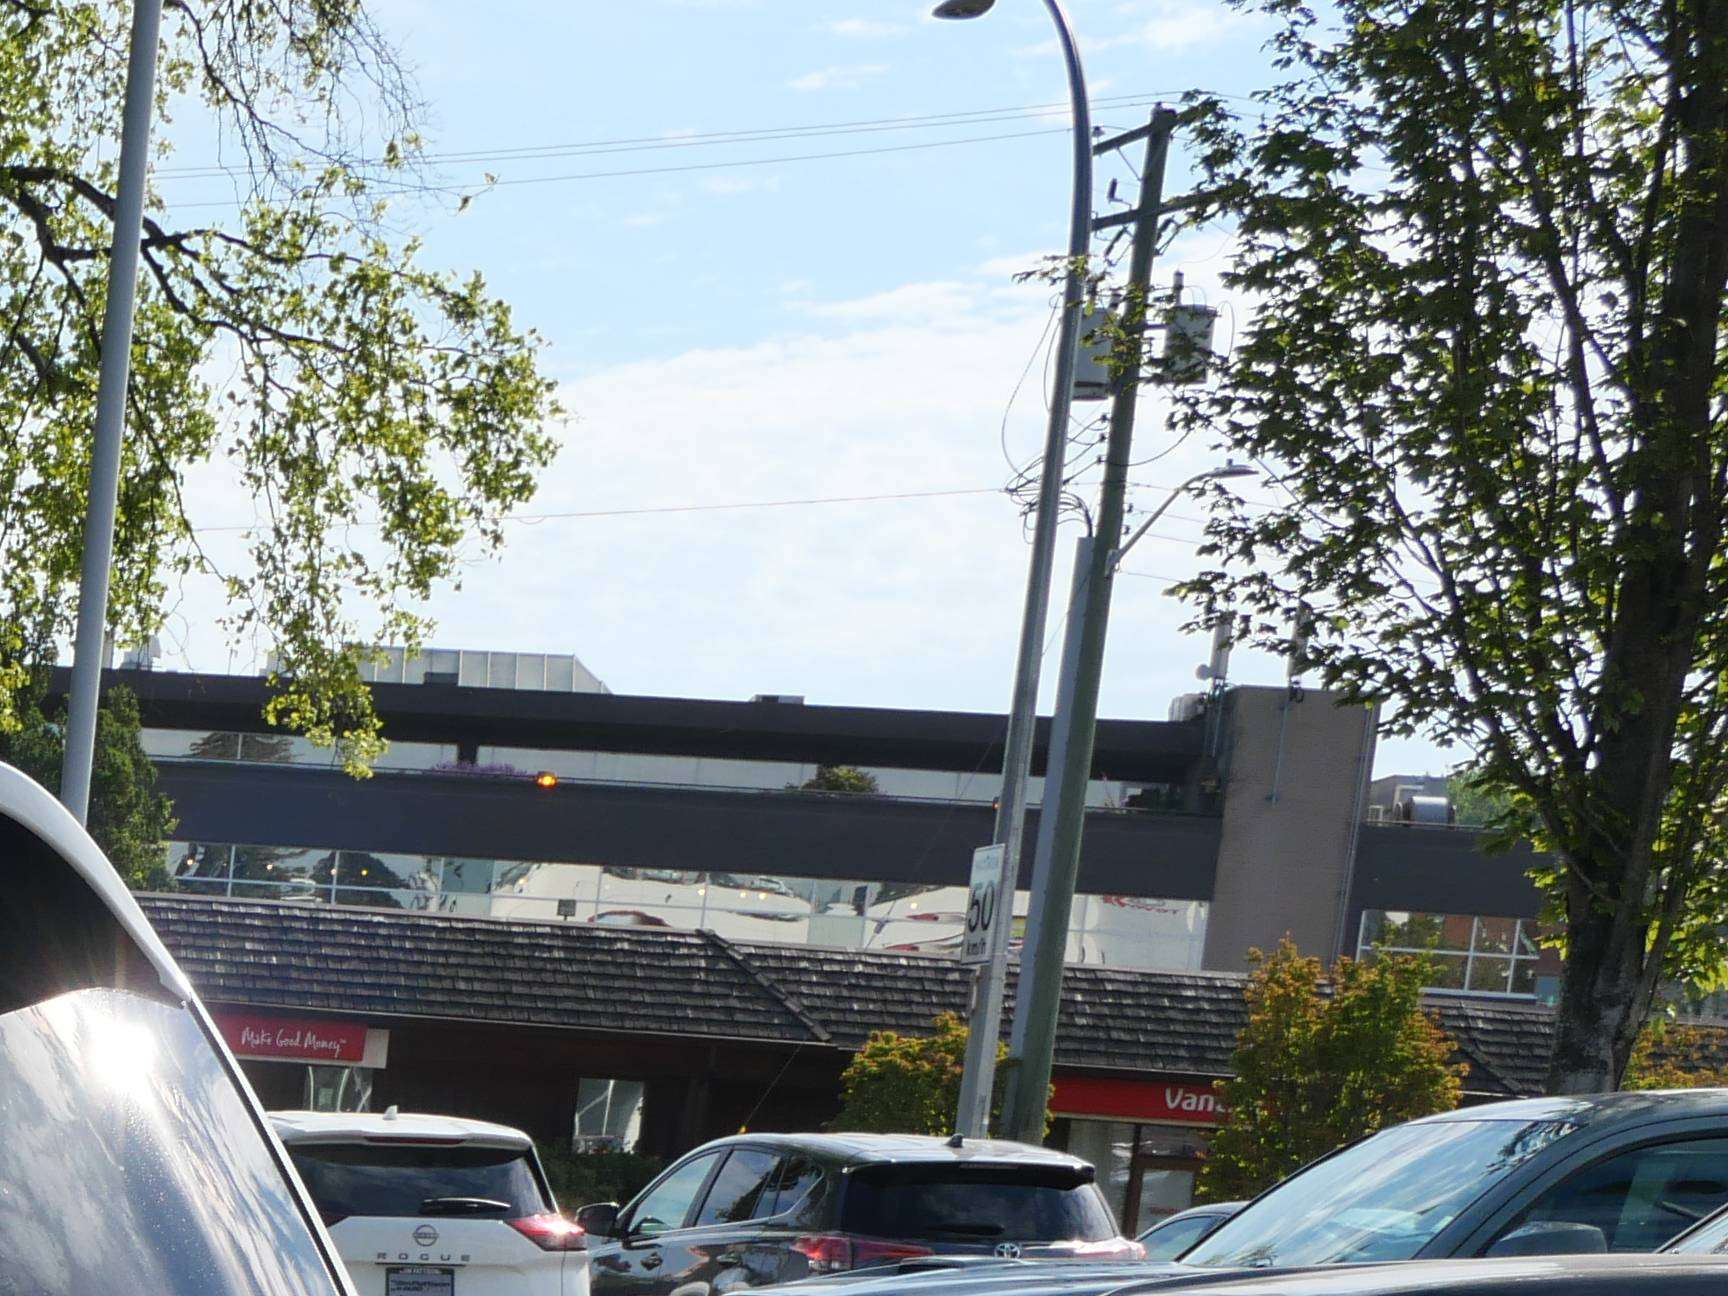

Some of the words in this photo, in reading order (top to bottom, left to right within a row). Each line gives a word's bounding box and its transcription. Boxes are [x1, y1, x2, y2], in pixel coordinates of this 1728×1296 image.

[968, 881, 995, 933] 50
[241, 1027, 273, 1048] Make
[275, 1028, 301, 1048] Good
[1165, 1087, 1232, 1113] Van
[377, 1253, 470, 1262] ROGUE
